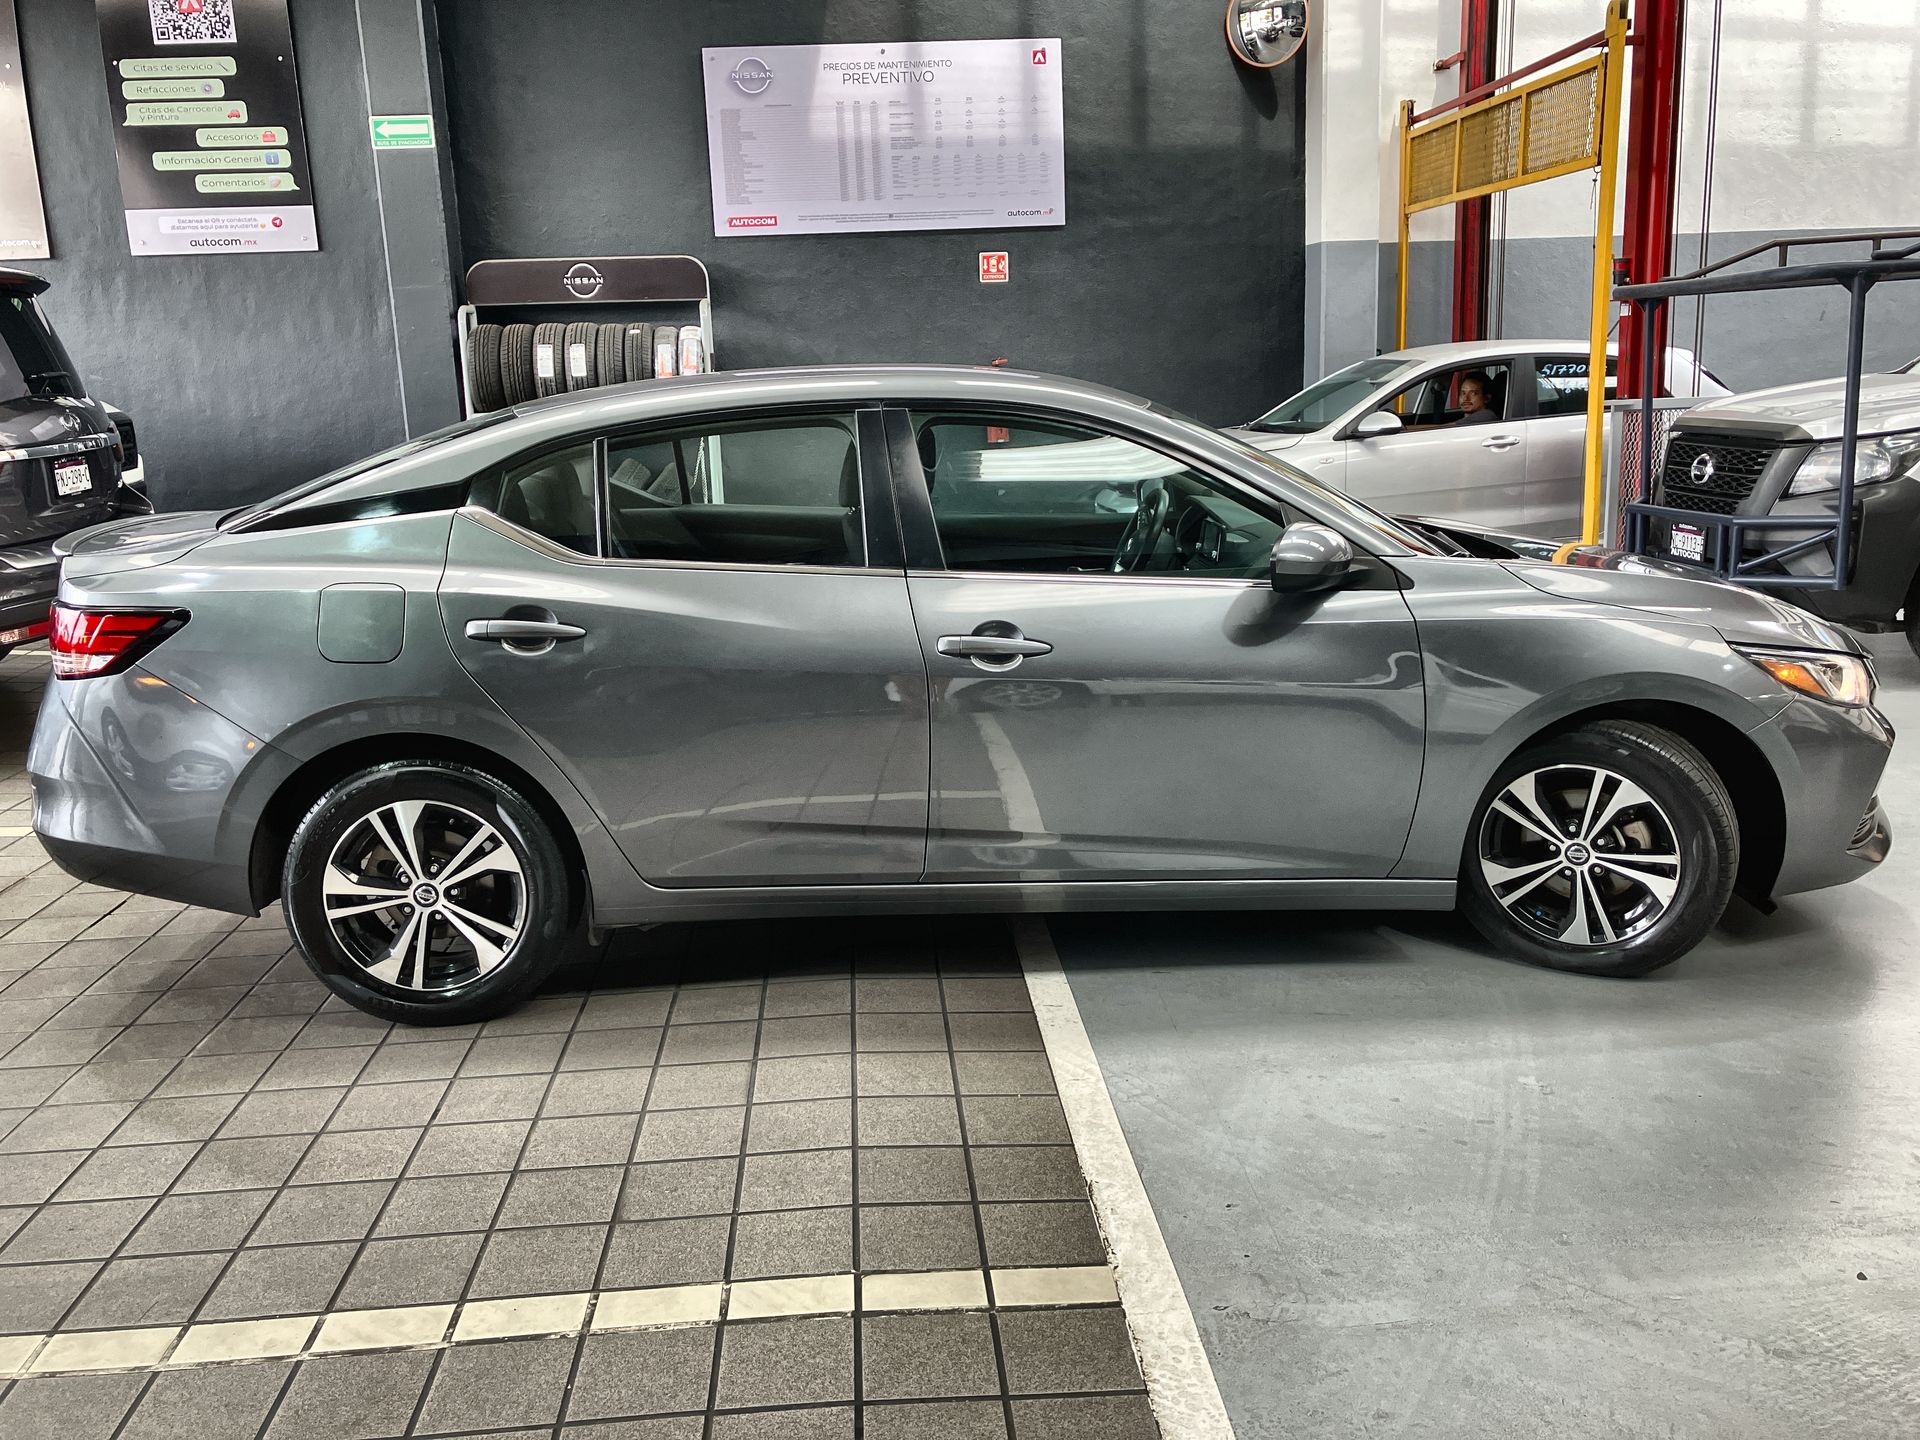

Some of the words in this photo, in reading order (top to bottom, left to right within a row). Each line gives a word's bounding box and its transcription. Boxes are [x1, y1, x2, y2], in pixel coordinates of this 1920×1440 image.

[133, 64, 159, 73] Citas
[175, 63, 213, 71] servicio
[822, 62, 862, 71] PRECIOS
[863, 61, 876, 70] DE
[877, 59, 953, 69] MANTENIMIENTO
[731, 71, 774, 79] NISSAN
[842, 70, 935, 85] PREVENTIVO
[136, 85, 196, 94] Refacciones
[139, 106, 162, 114] Citas
[206, 133, 259, 142] Accesorios
[223, 155, 262, 163] General
[201, 179, 266, 188] Comentarios
[731, 217, 776, 226] AUTOCOM
[189, 238, 258, 247] autocom.mx
[563, 276, 604, 285] NISSAN
[1670, 547, 1701, 561] AUTOCOM
